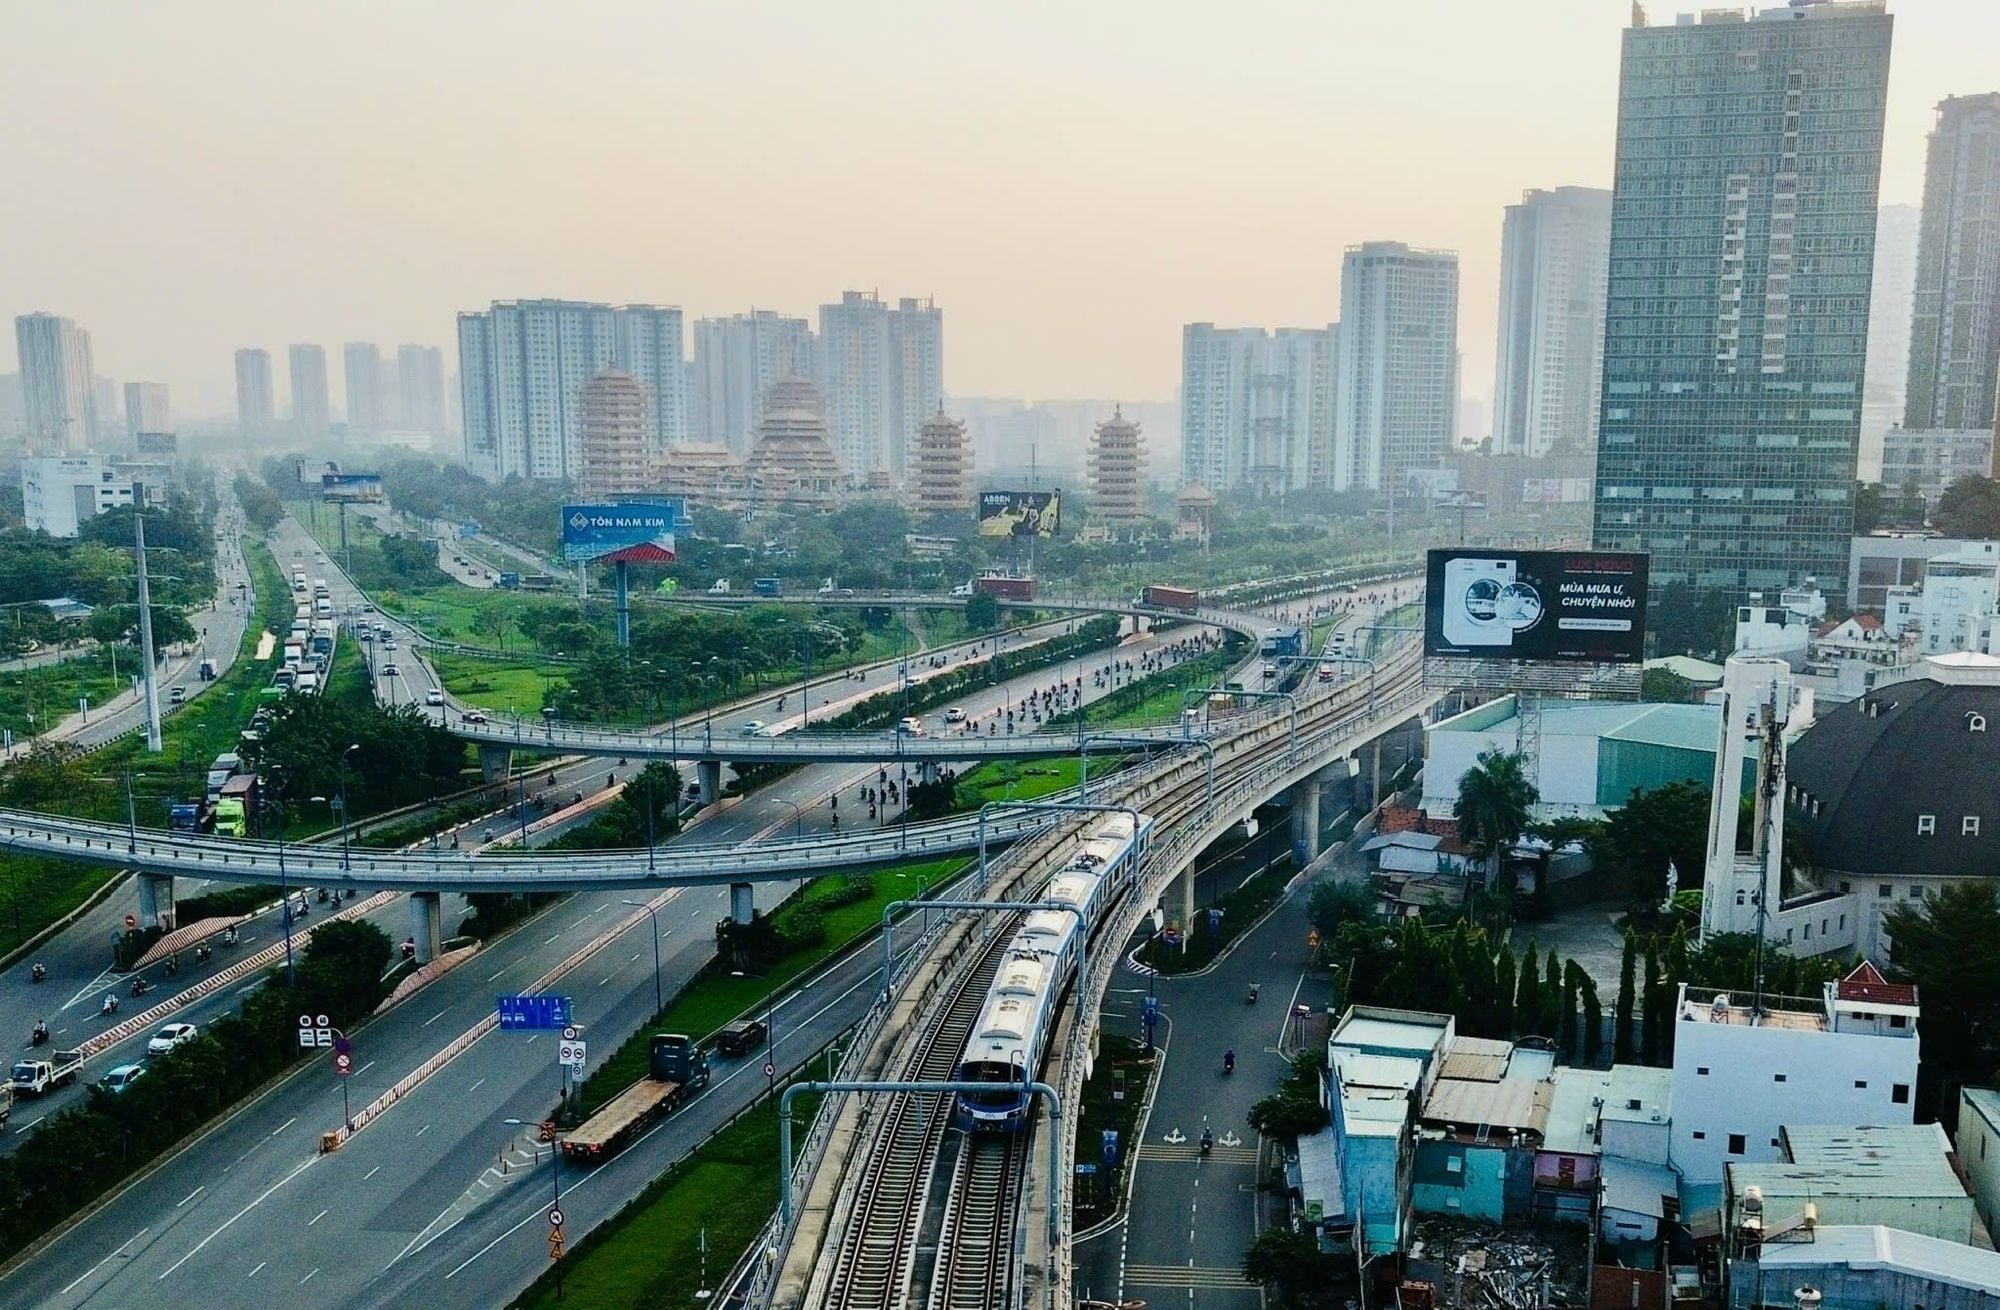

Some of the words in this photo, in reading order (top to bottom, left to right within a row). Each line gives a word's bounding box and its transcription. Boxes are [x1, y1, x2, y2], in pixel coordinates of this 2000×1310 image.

[590, 516, 613, 527] TÔN
[616, 518, 641, 527] NAM
[645, 518, 665, 527] KIM
[1559, 582, 1584, 593] MÙA
[1586, 583, 1611, 594] MƯA
[1562, 595, 1605, 608] CHUYỆN
[1607, 597, 1635, 607] NHỎ!
